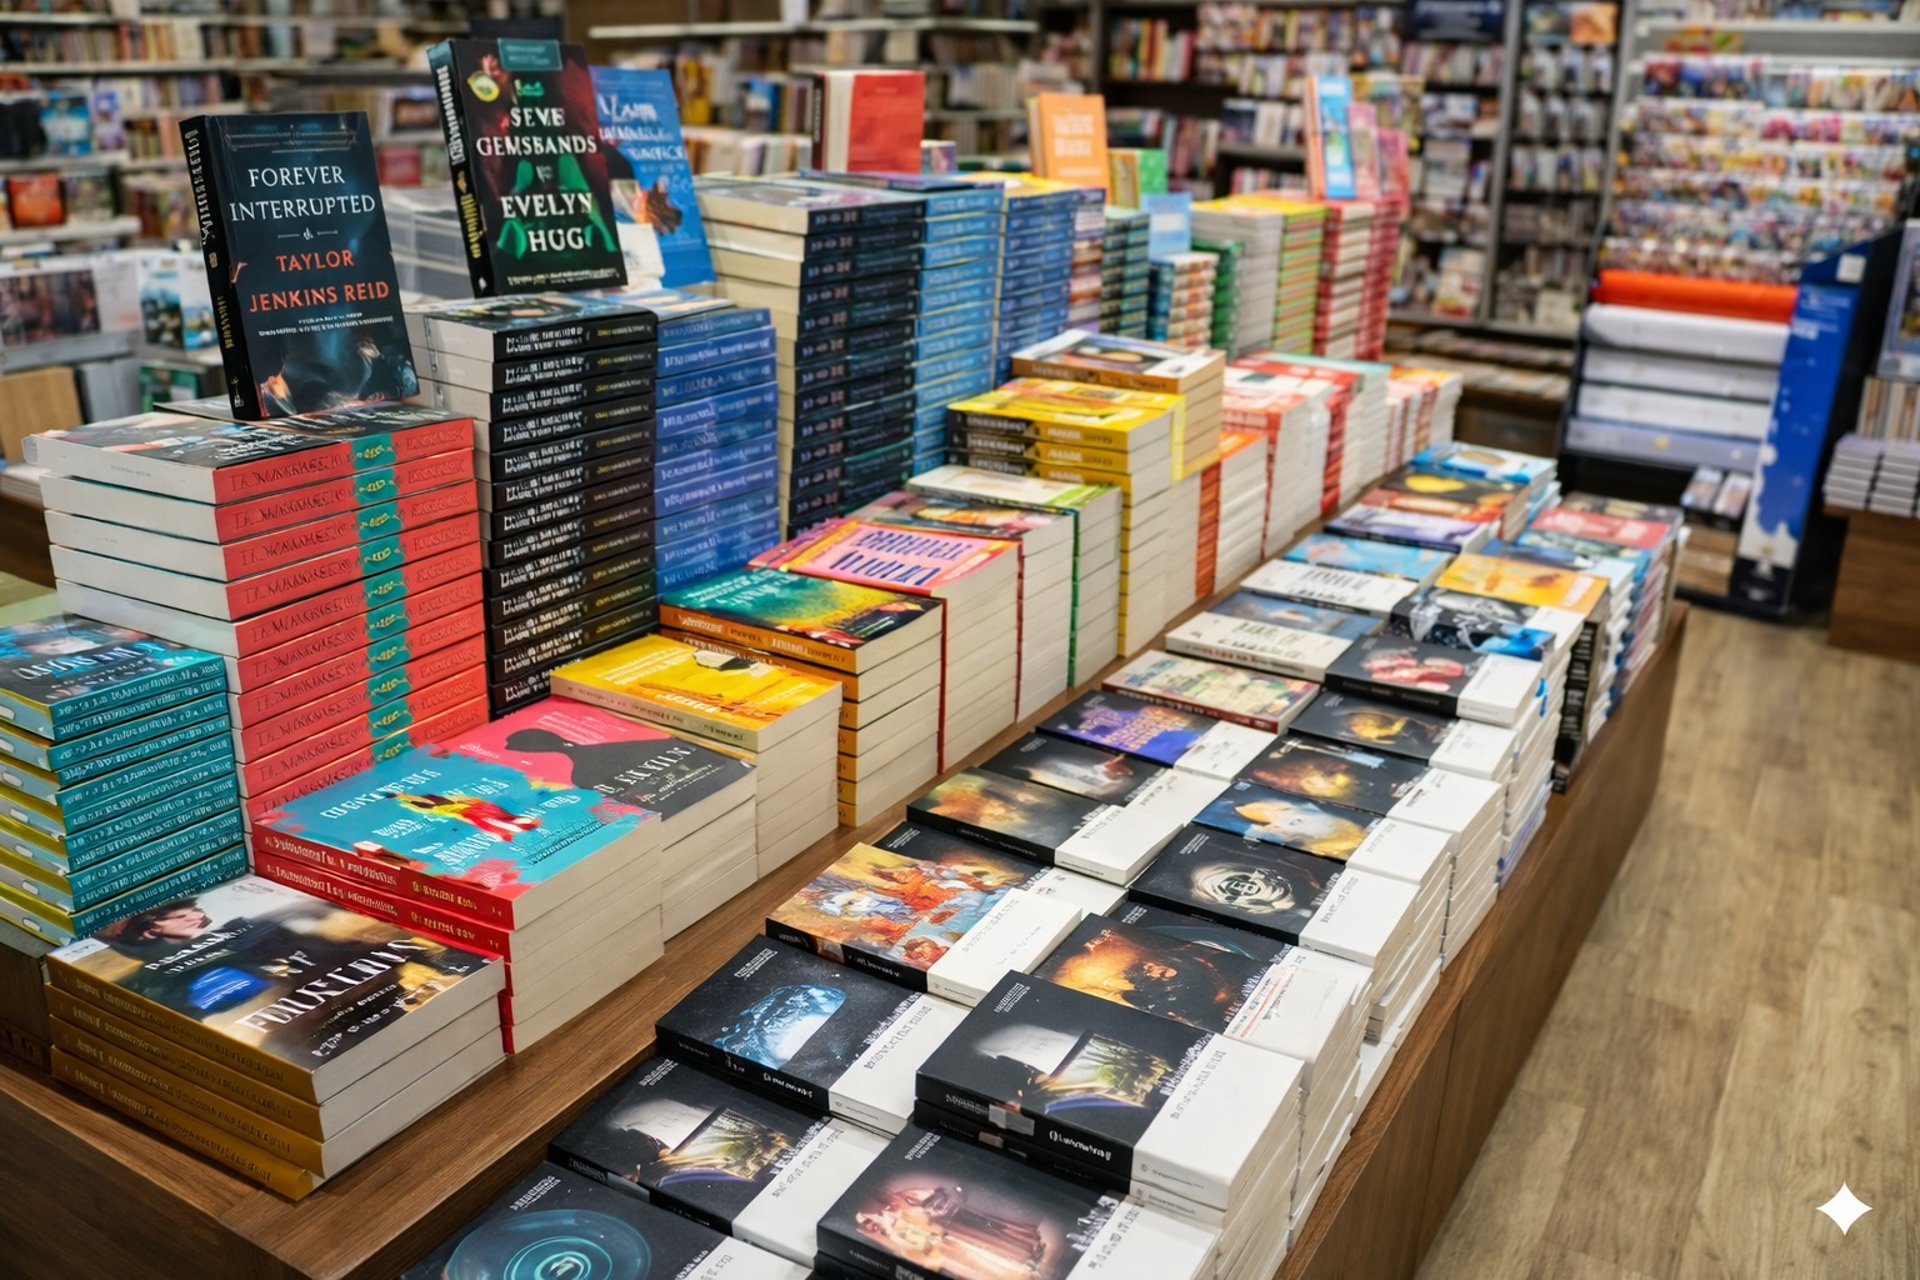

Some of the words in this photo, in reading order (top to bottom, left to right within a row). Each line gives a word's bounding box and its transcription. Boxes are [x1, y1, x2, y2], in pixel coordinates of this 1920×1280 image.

[248, 165, 346, 188] FOREVER
[229, 194, 376, 222] INTERRUPTED
[500, 192, 594, 219] EVELYN
[275, 249, 355, 272] TAYLOR
[249, 286, 338, 313] JENKINS
[343, 280, 390, 300] REID
